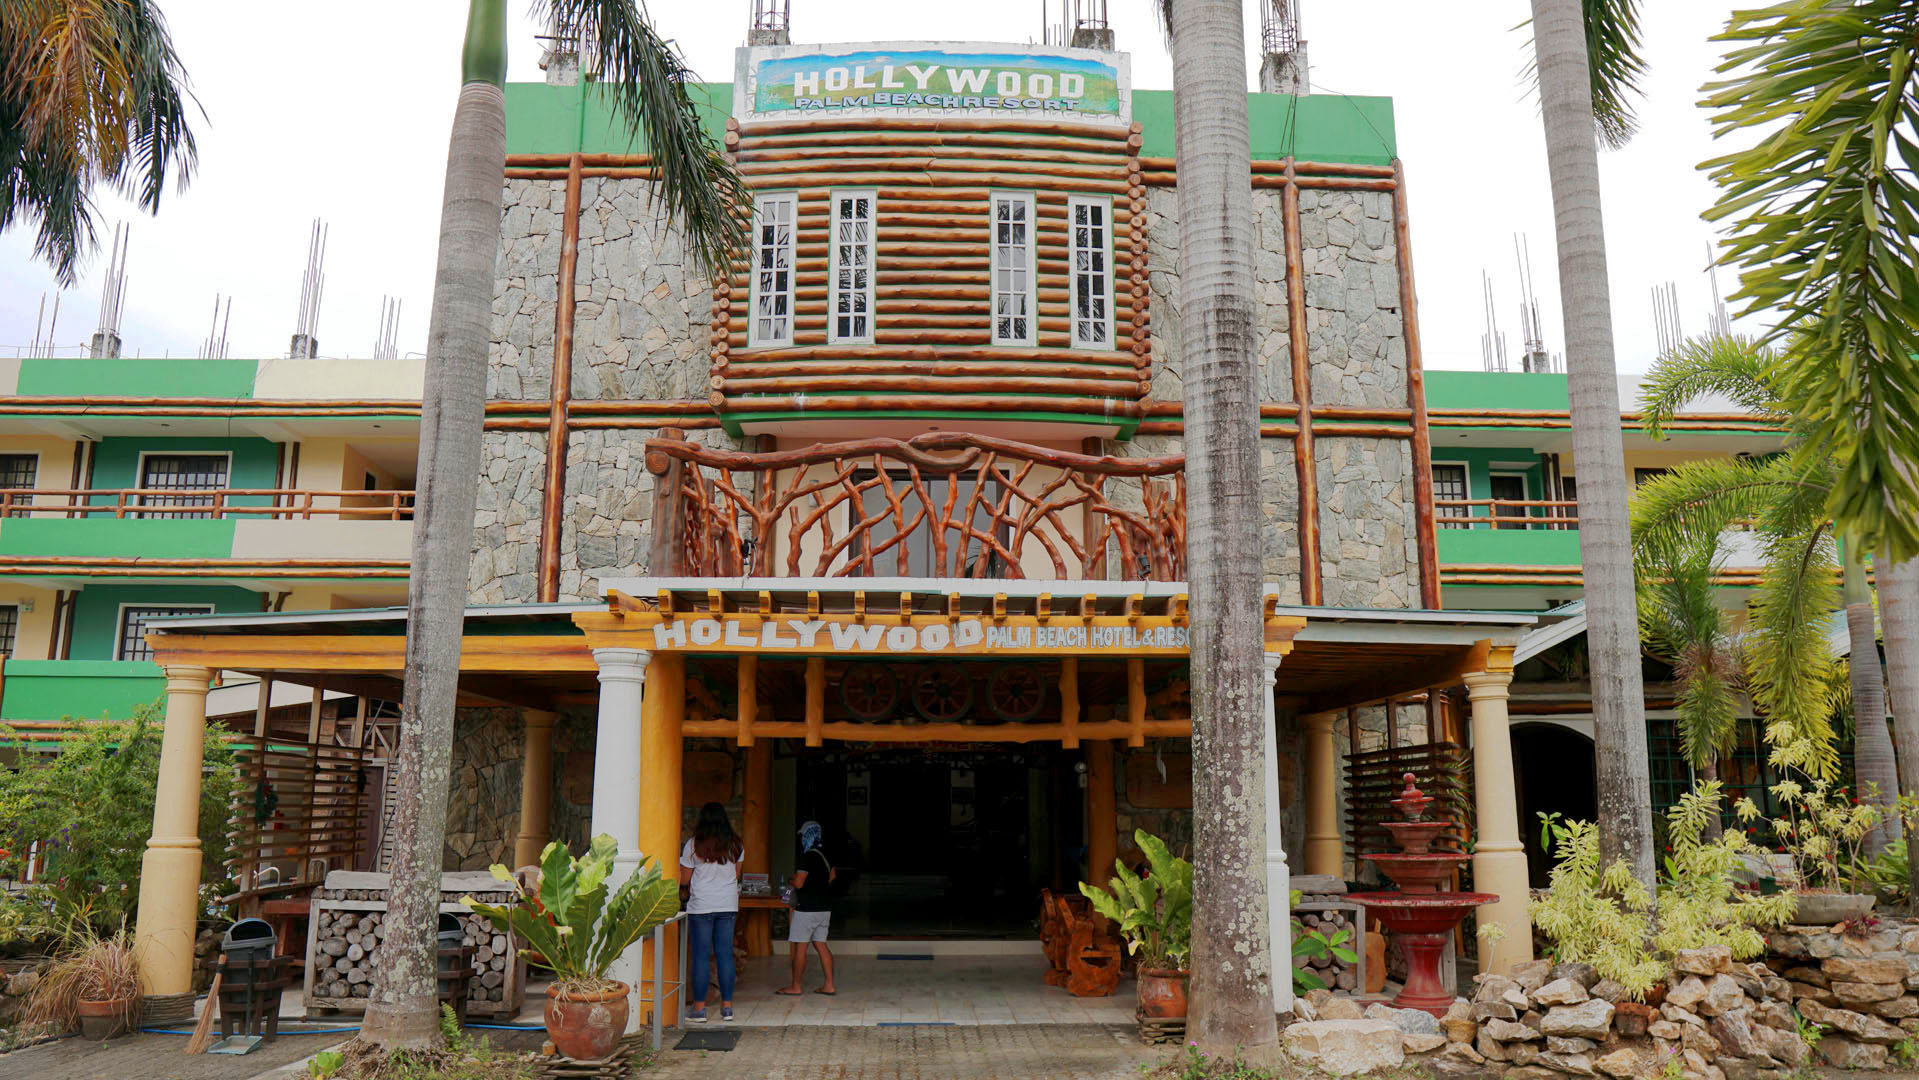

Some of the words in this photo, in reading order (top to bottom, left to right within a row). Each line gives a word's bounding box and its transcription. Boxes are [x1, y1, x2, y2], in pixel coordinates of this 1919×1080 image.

[793, 65, 1085, 99] HOLLYWOOD
[794, 95, 869, 109] PALM
[653, 618, 984, 652] HOLLYWOOD
[986, 625, 1032, 649] PALM
[1035, 625, 1087, 649] BEACH
